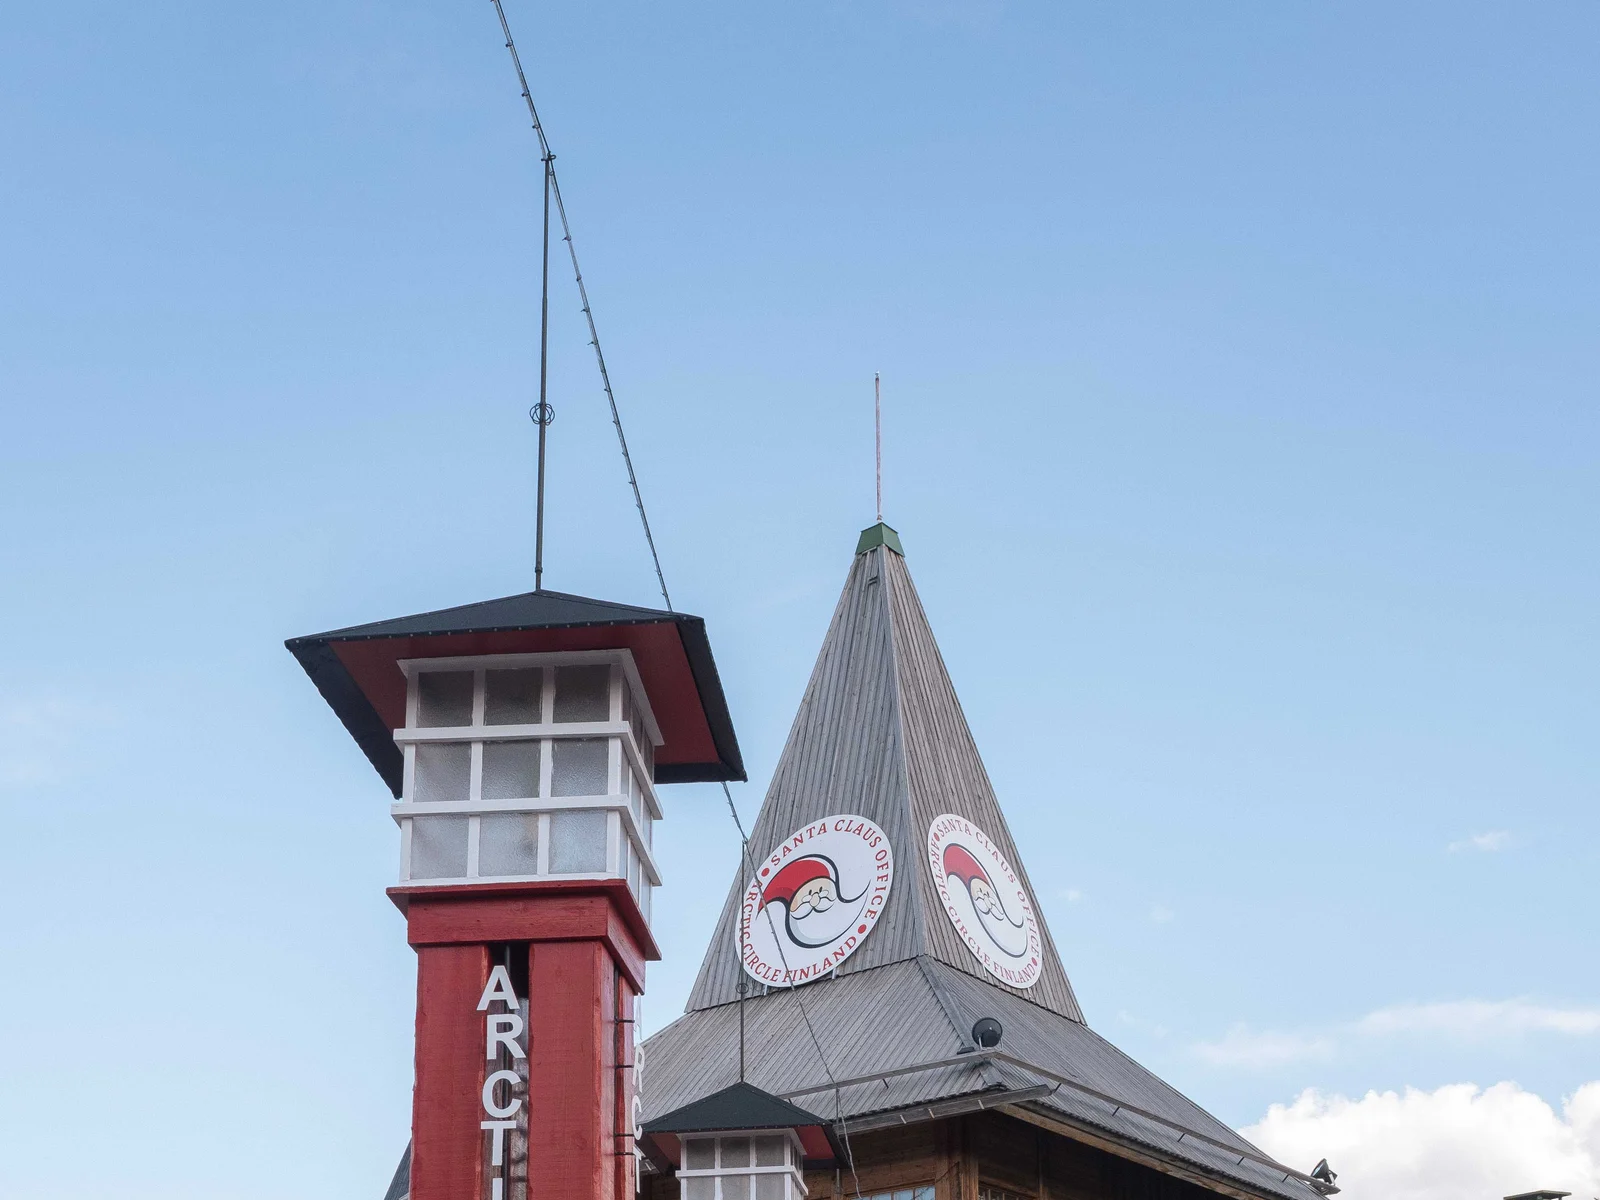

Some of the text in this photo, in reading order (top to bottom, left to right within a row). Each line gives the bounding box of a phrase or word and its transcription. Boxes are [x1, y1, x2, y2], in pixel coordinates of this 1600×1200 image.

[770, 819, 889, 920] SANTA CLAUS OFFICE
[929, 838, 1035, 984] ARCTIC CIRCLE FINLAND
[936, 818, 1040, 958] SANTA CLAUS OFFICE
[743, 942, 781, 983] CIRCLE
[782, 936, 857, 982] FINLAND
